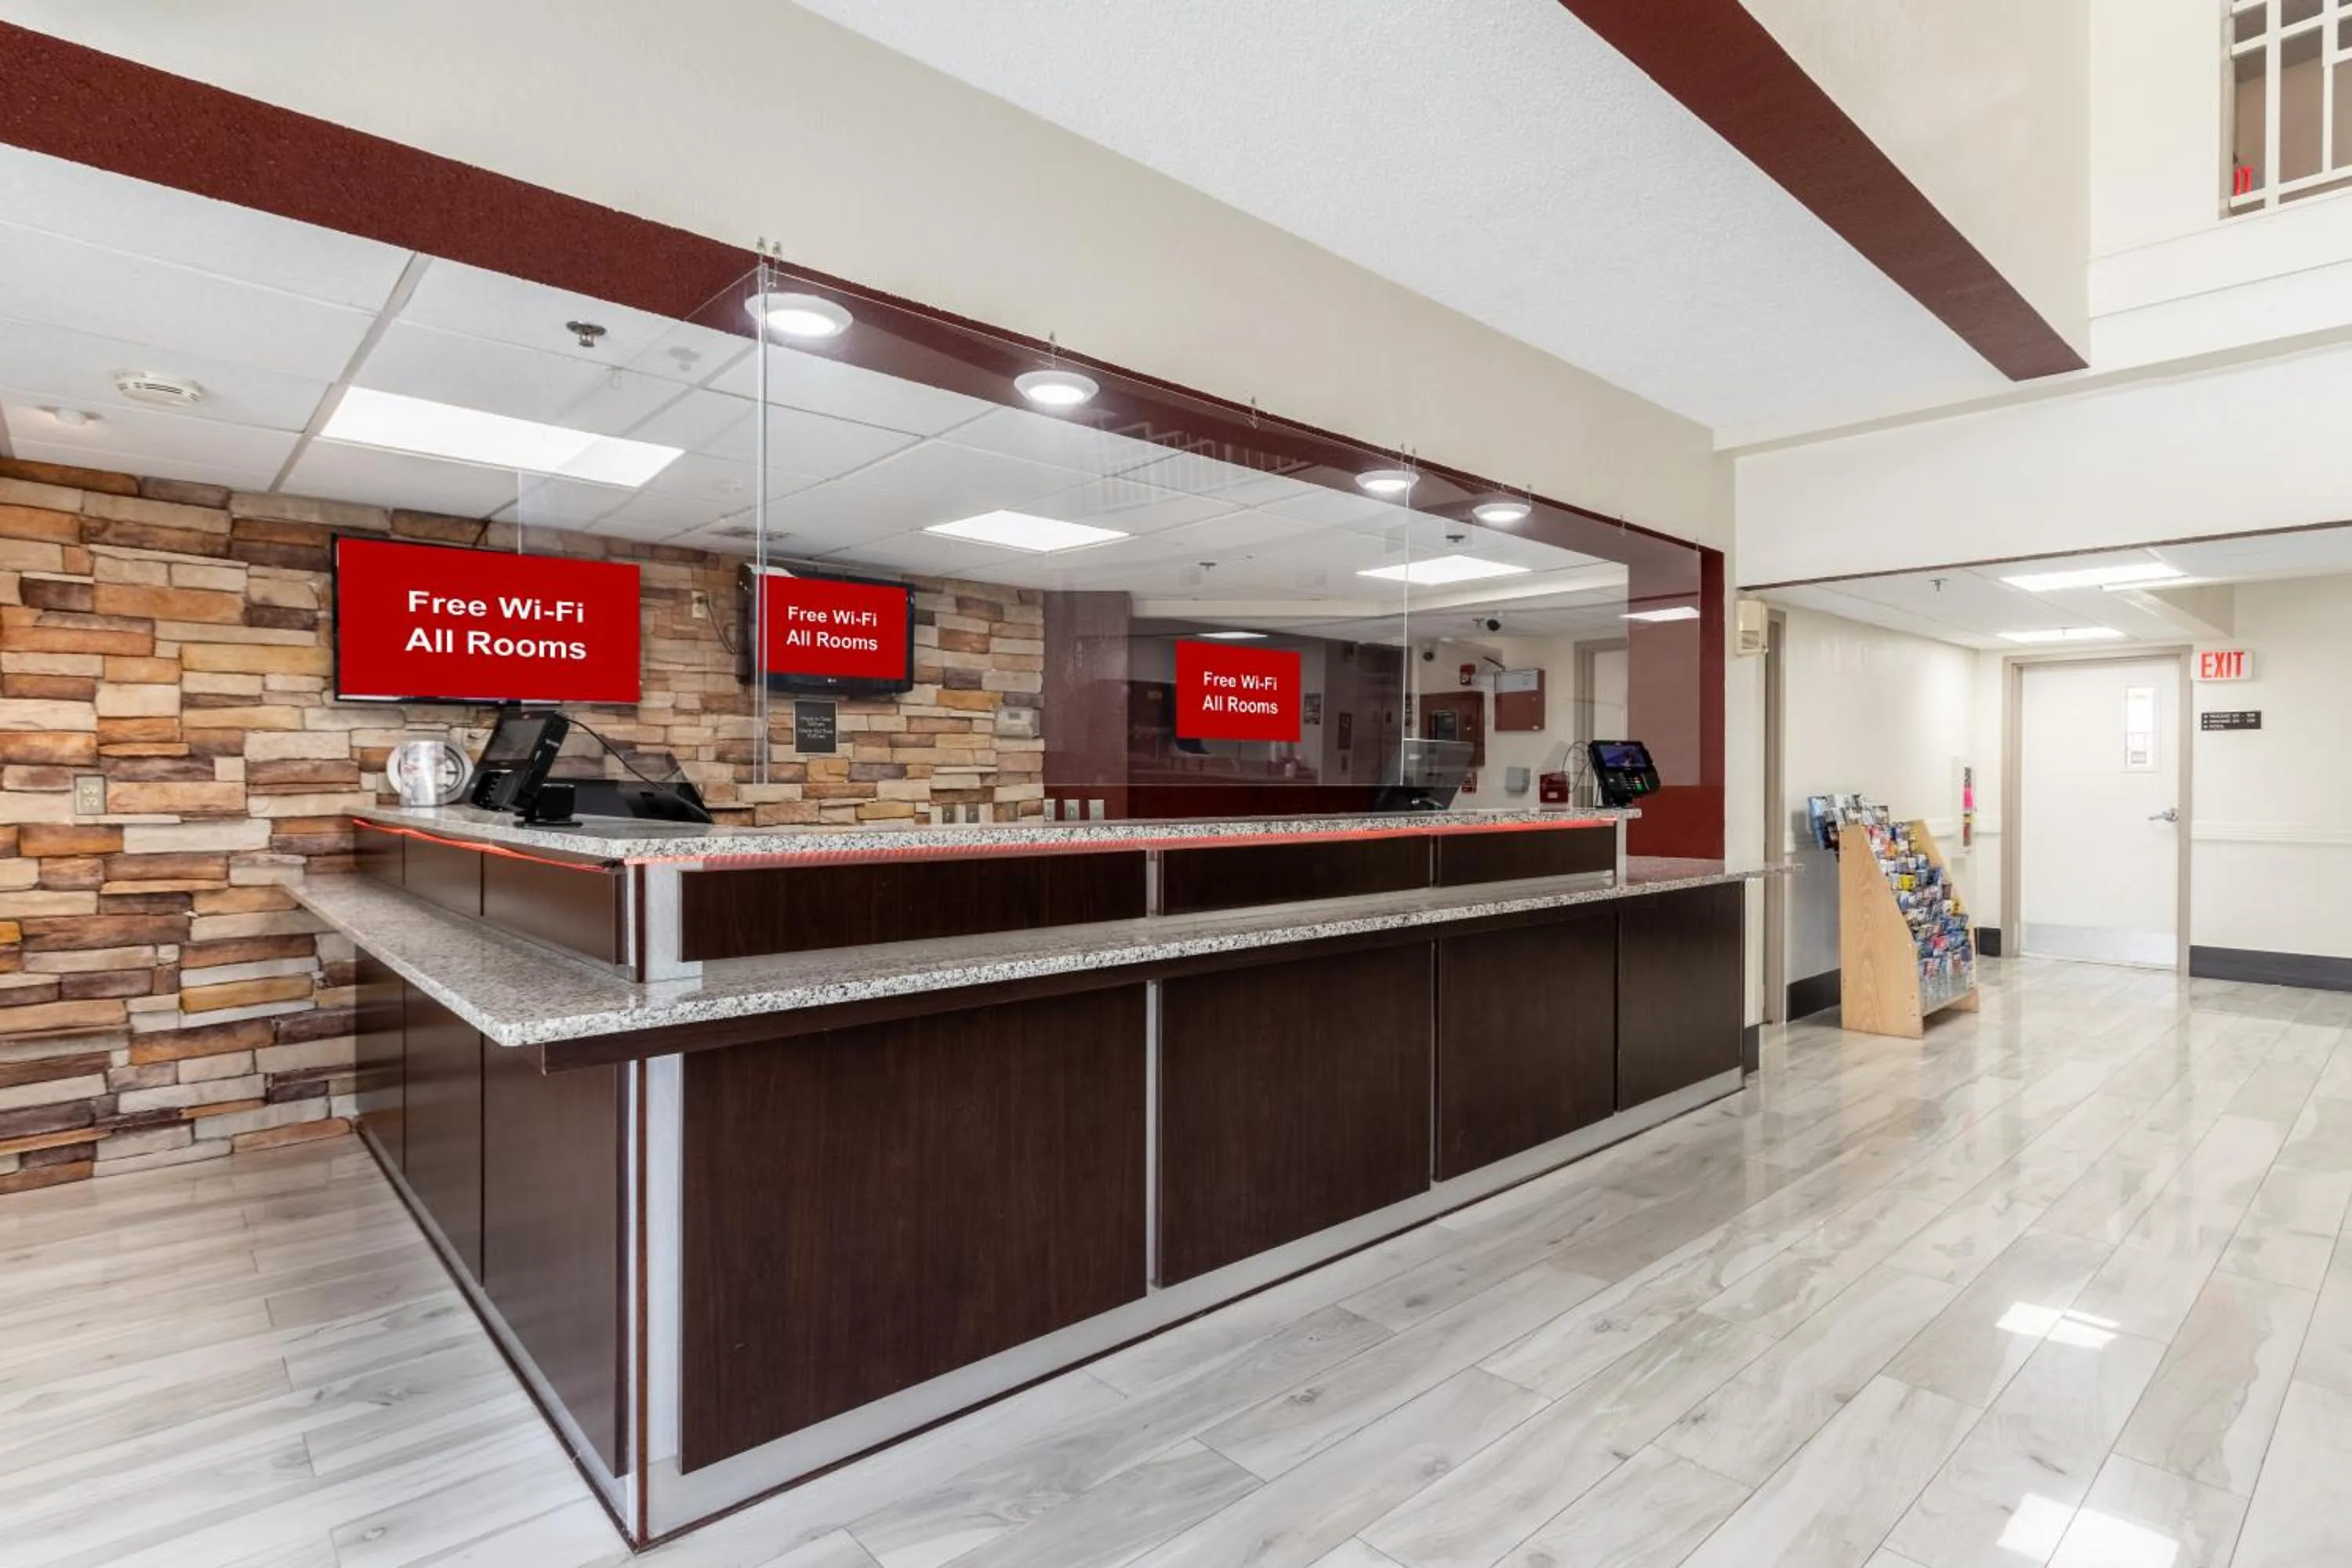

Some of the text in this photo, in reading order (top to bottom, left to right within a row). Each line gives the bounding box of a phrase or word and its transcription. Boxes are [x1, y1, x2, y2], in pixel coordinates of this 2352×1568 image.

[408, 590, 584, 623] Free Wi-Fi
[788, 605, 877, 626] Free Wi-Fi
[405, 627, 586, 659] All Rooms
[786, 629, 878, 651] All Rooms
[2201, 652, 2245, 678] EXIT
[1203, 671, 1277, 691] Free Wi-Fi
[1203, 695, 1278, 714] All Rooms
